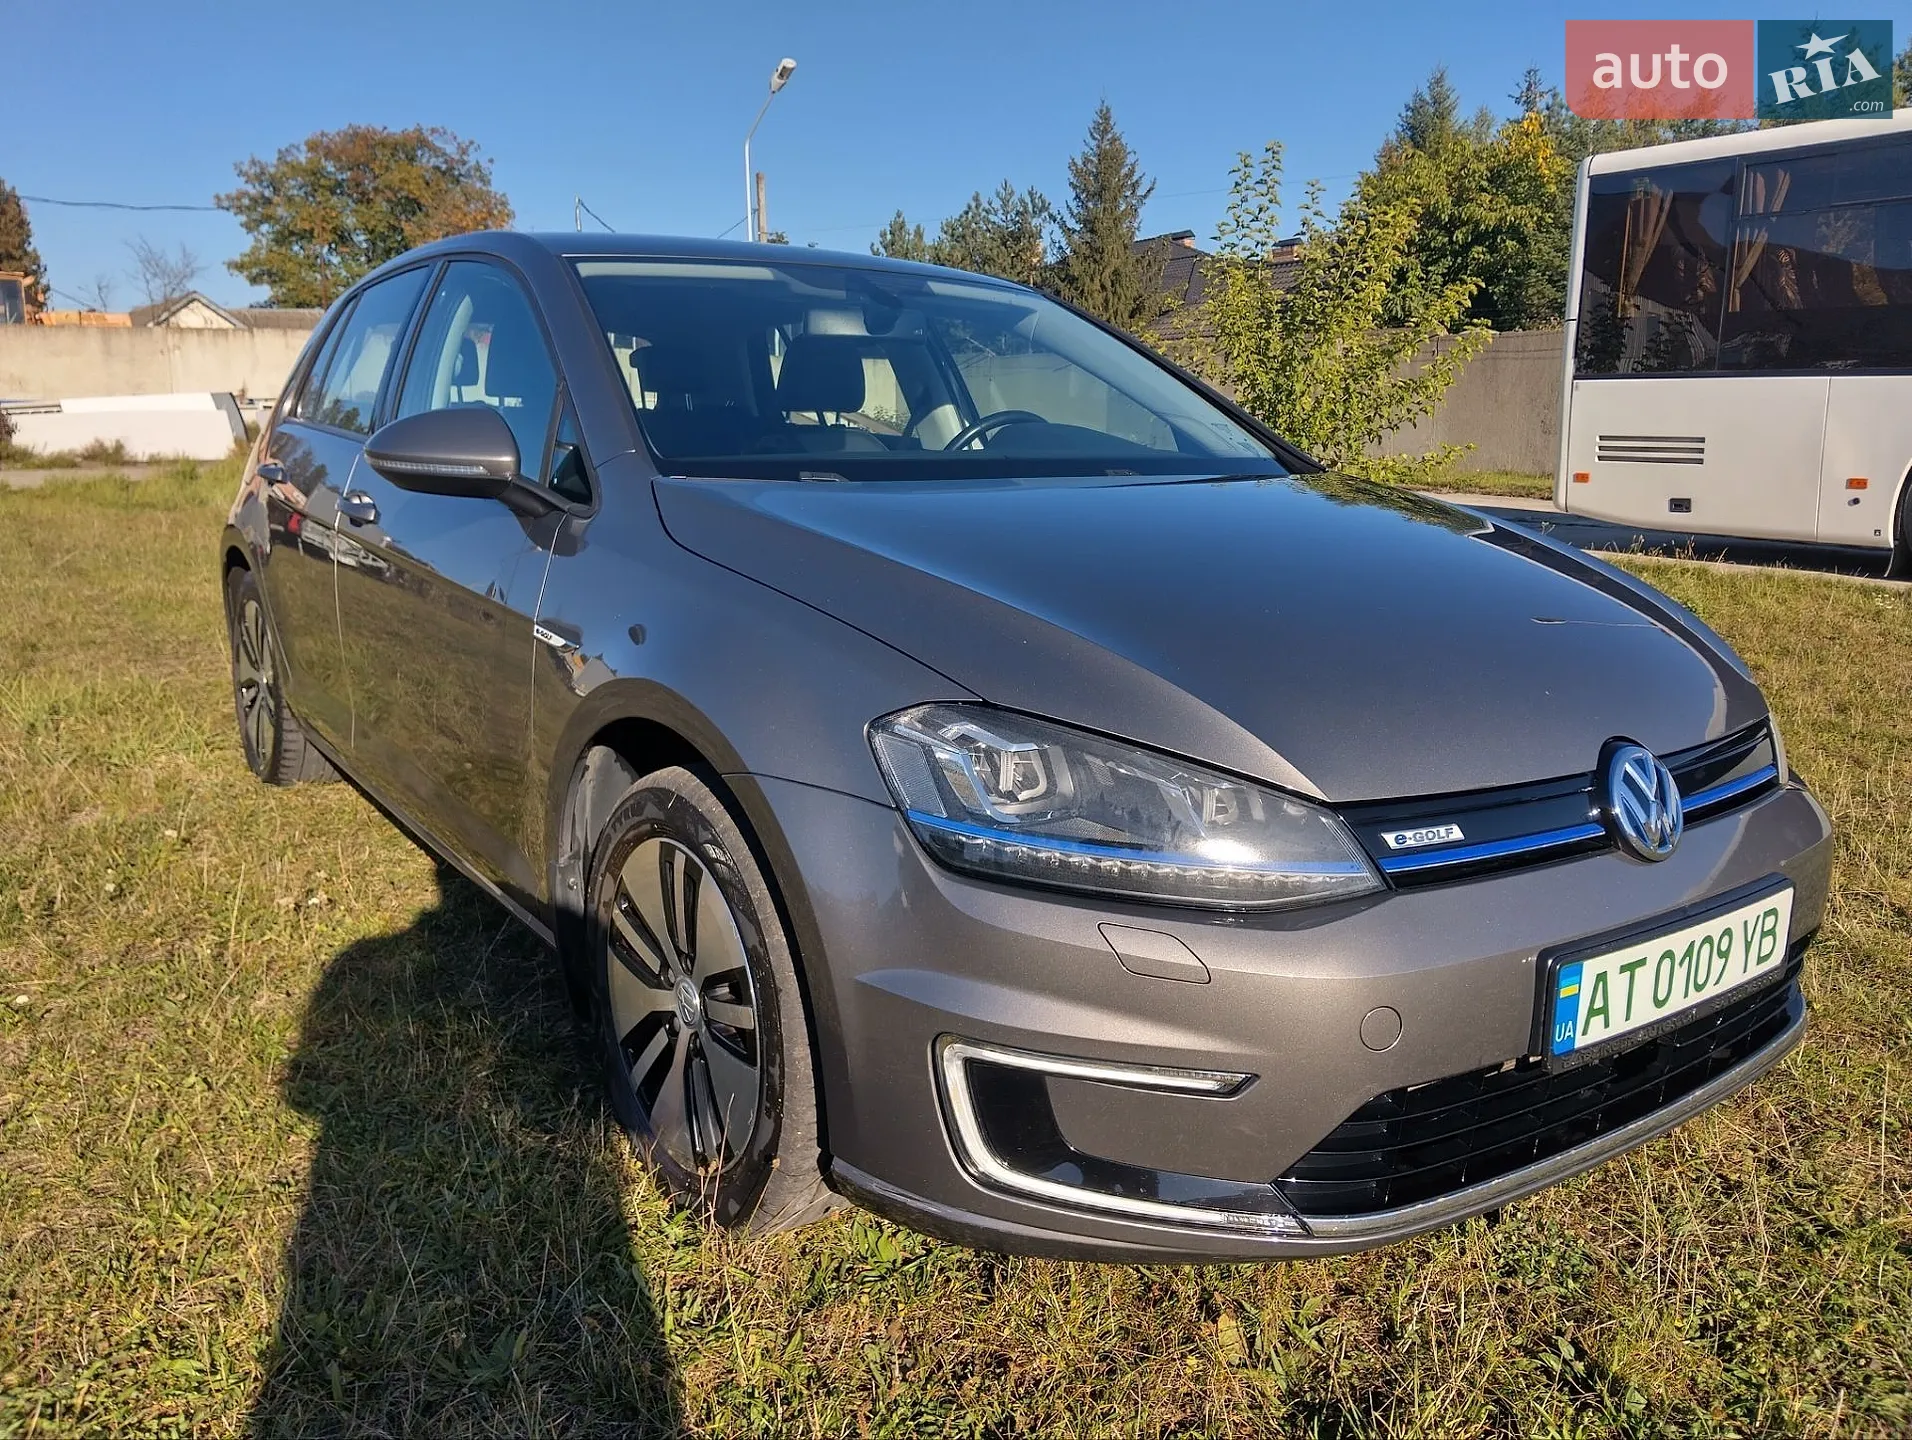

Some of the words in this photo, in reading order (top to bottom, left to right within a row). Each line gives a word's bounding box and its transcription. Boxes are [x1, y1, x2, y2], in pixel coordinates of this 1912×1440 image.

[1393, 826, 1455, 846] e-GOLF
[1581, 956, 1648, 1036] AT
[1652, 927, 1733, 1009] 0109
[1743, 907, 1779, 974] YB
[1555, 1020, 1574, 1042] UA
